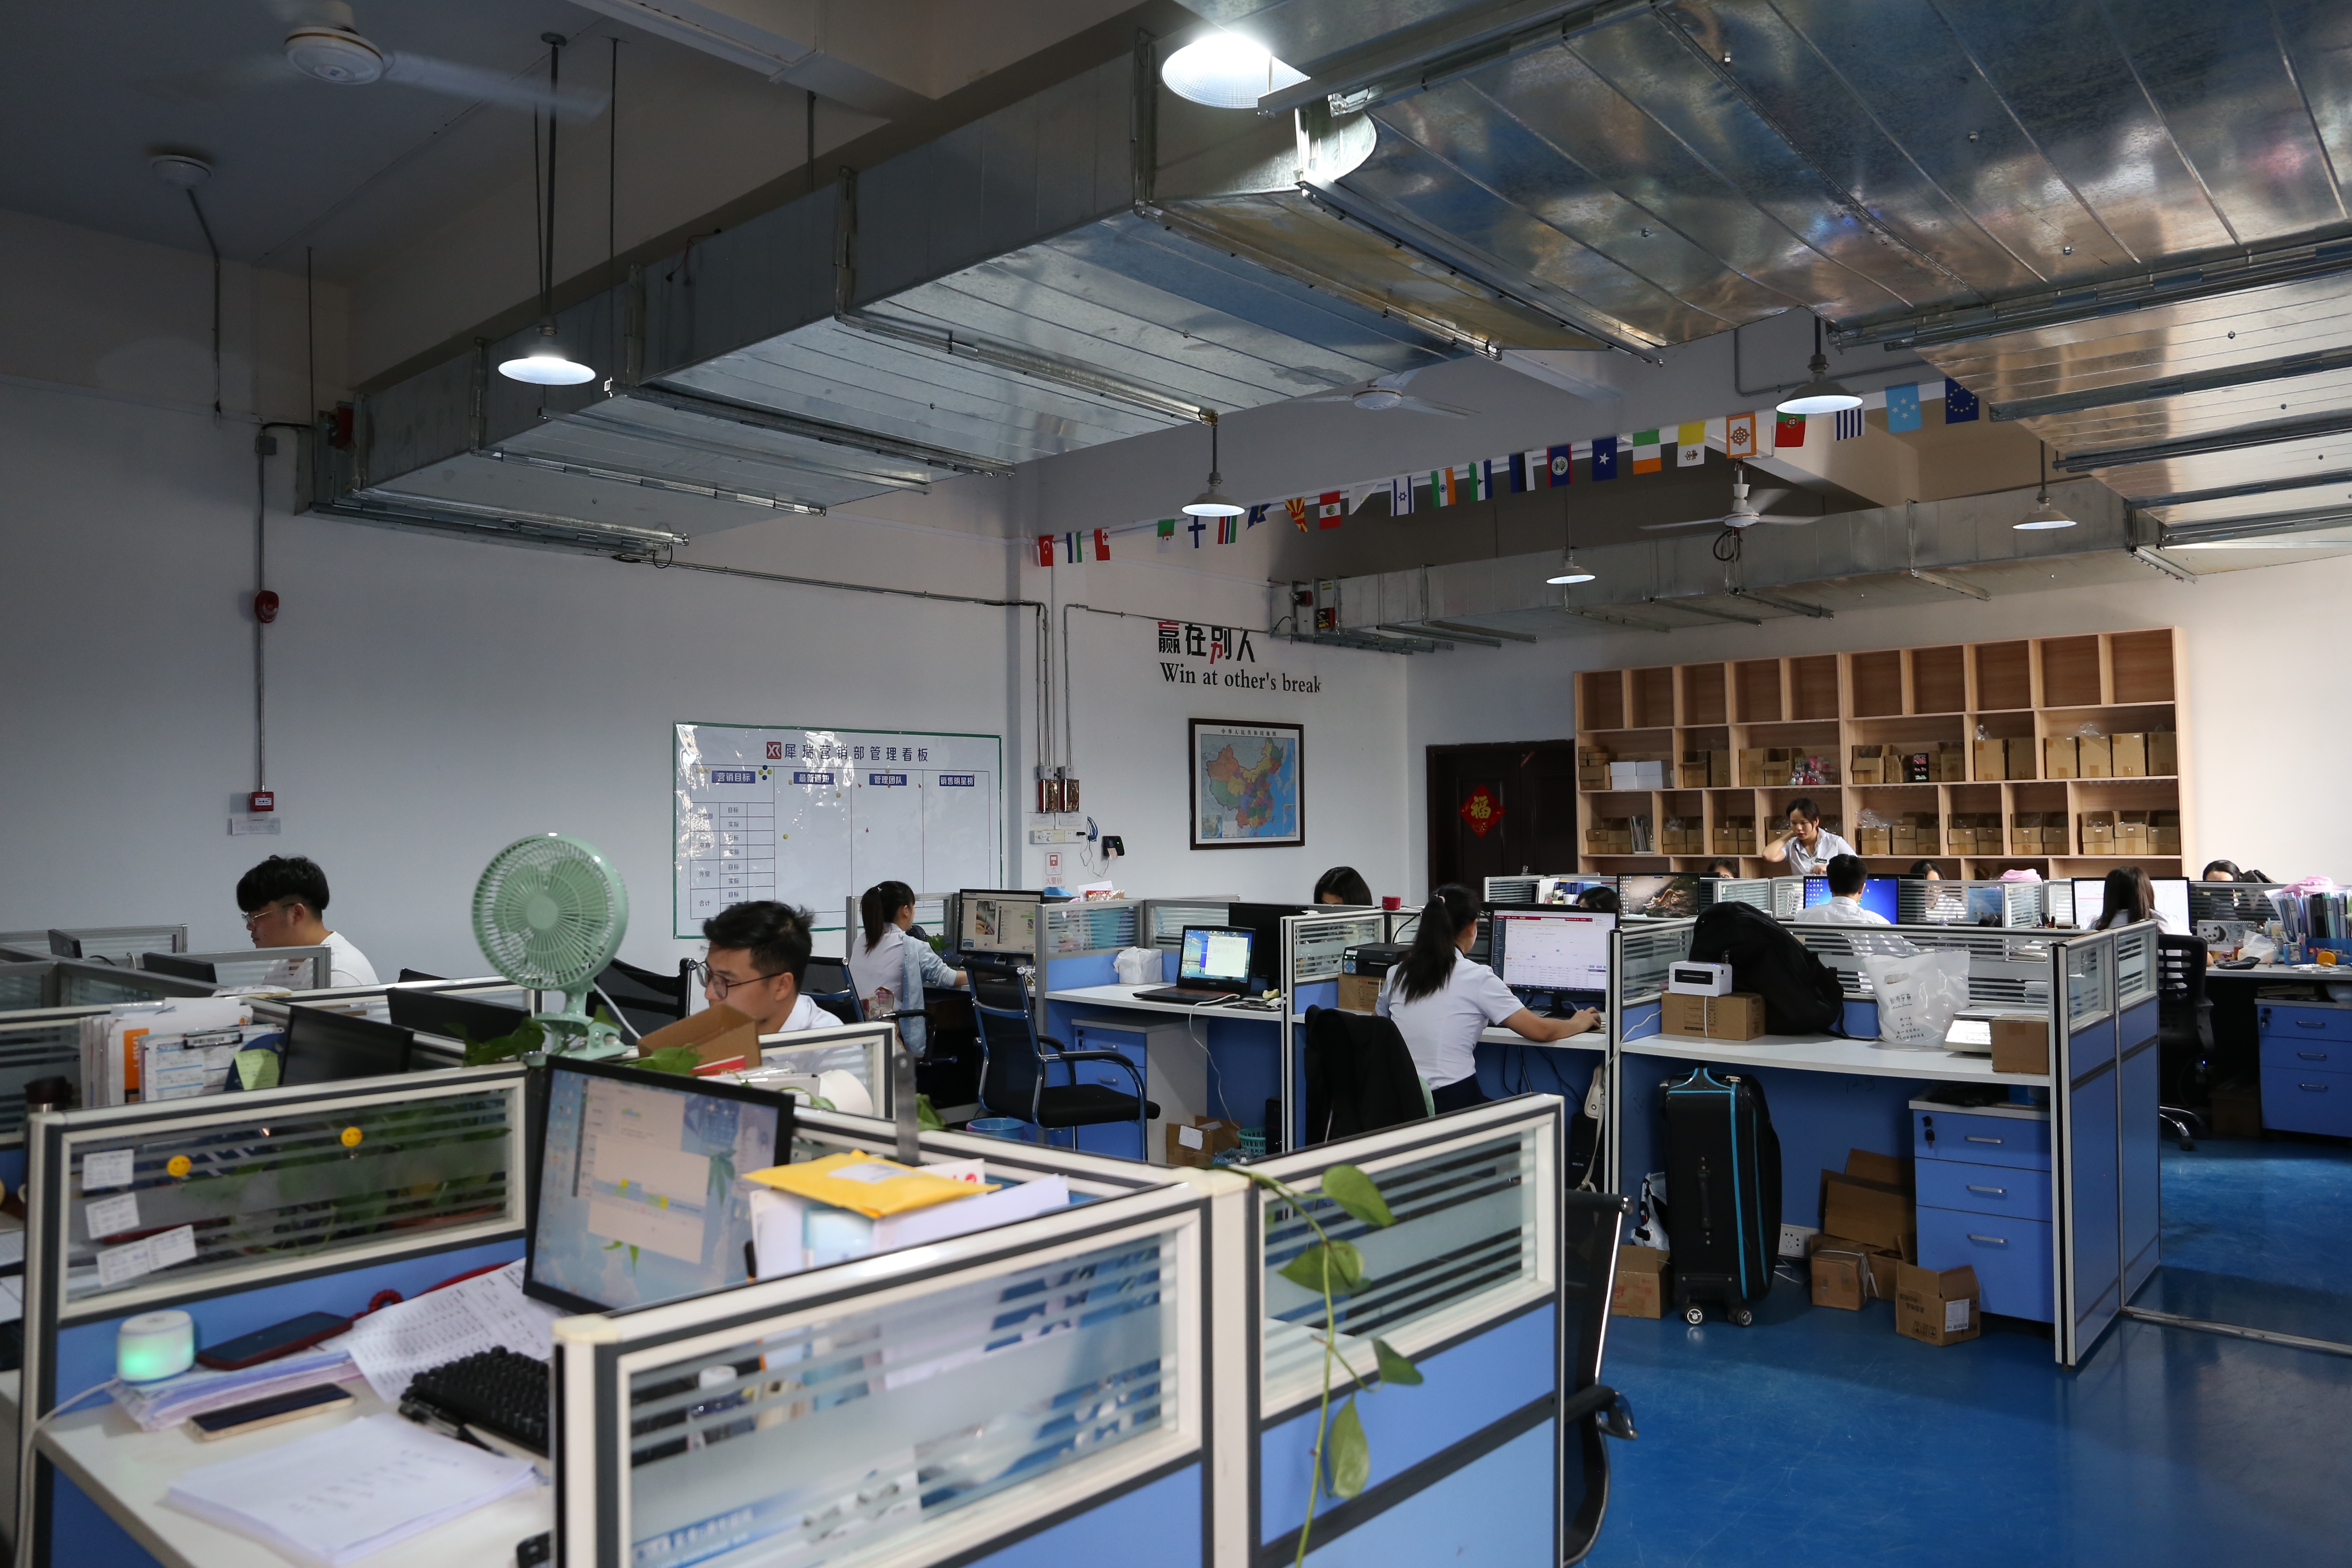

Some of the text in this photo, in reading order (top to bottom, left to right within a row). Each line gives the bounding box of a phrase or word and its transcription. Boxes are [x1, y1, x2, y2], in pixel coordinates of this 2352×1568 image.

[1157, 621, 1256, 665] 赢在别人
[1159, 662, 1322, 693] Win at other's break
[1221, 728, 1277, 737] 中华人民共和国地图
[784, 744, 928, 762] 犀瑞营销部管理看板
[717, 772, 750, 782] 营销目标
[799, 774, 830, 783] 最新通知
[874, 775, 902, 784] 管理团队
[940, 776, 974, 785] 销售明星榜
[1470, 795, 1491, 819] 福
